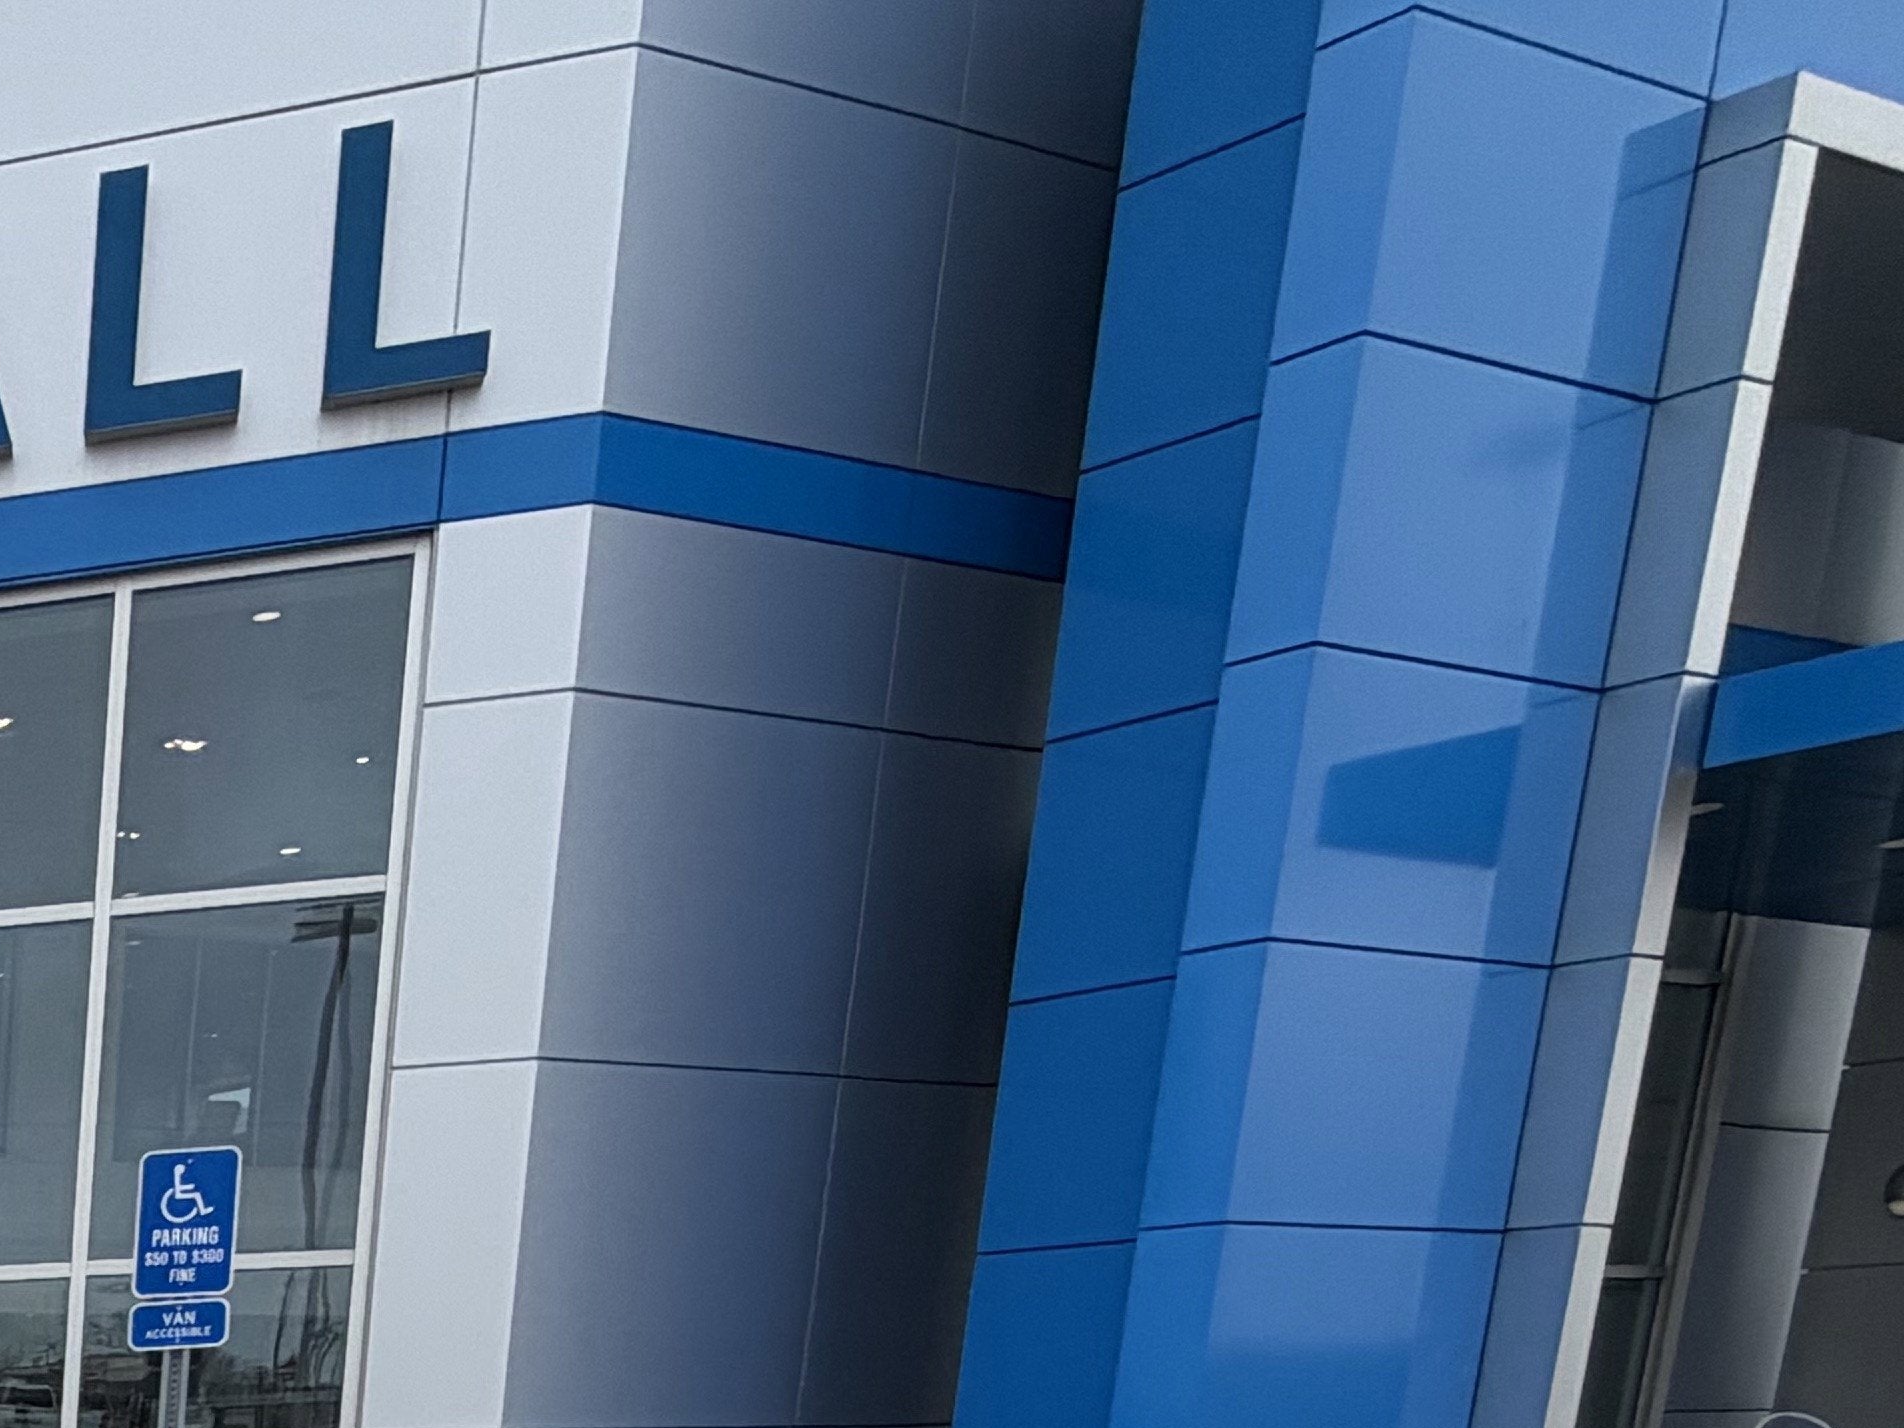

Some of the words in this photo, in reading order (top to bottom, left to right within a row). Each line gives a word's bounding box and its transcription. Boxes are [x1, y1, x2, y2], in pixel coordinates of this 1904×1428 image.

[151, 1225, 221, 1248] PARKING
[144, 1251, 170, 1267] $50
[172, 1250, 188, 1265] TO
[191, 1248, 225, 1264] $300
[168, 1267, 197, 1283] FINE
[162, 1310, 197, 1327] VAN
[145, 1324, 212, 1340] ACCESSIBLE
